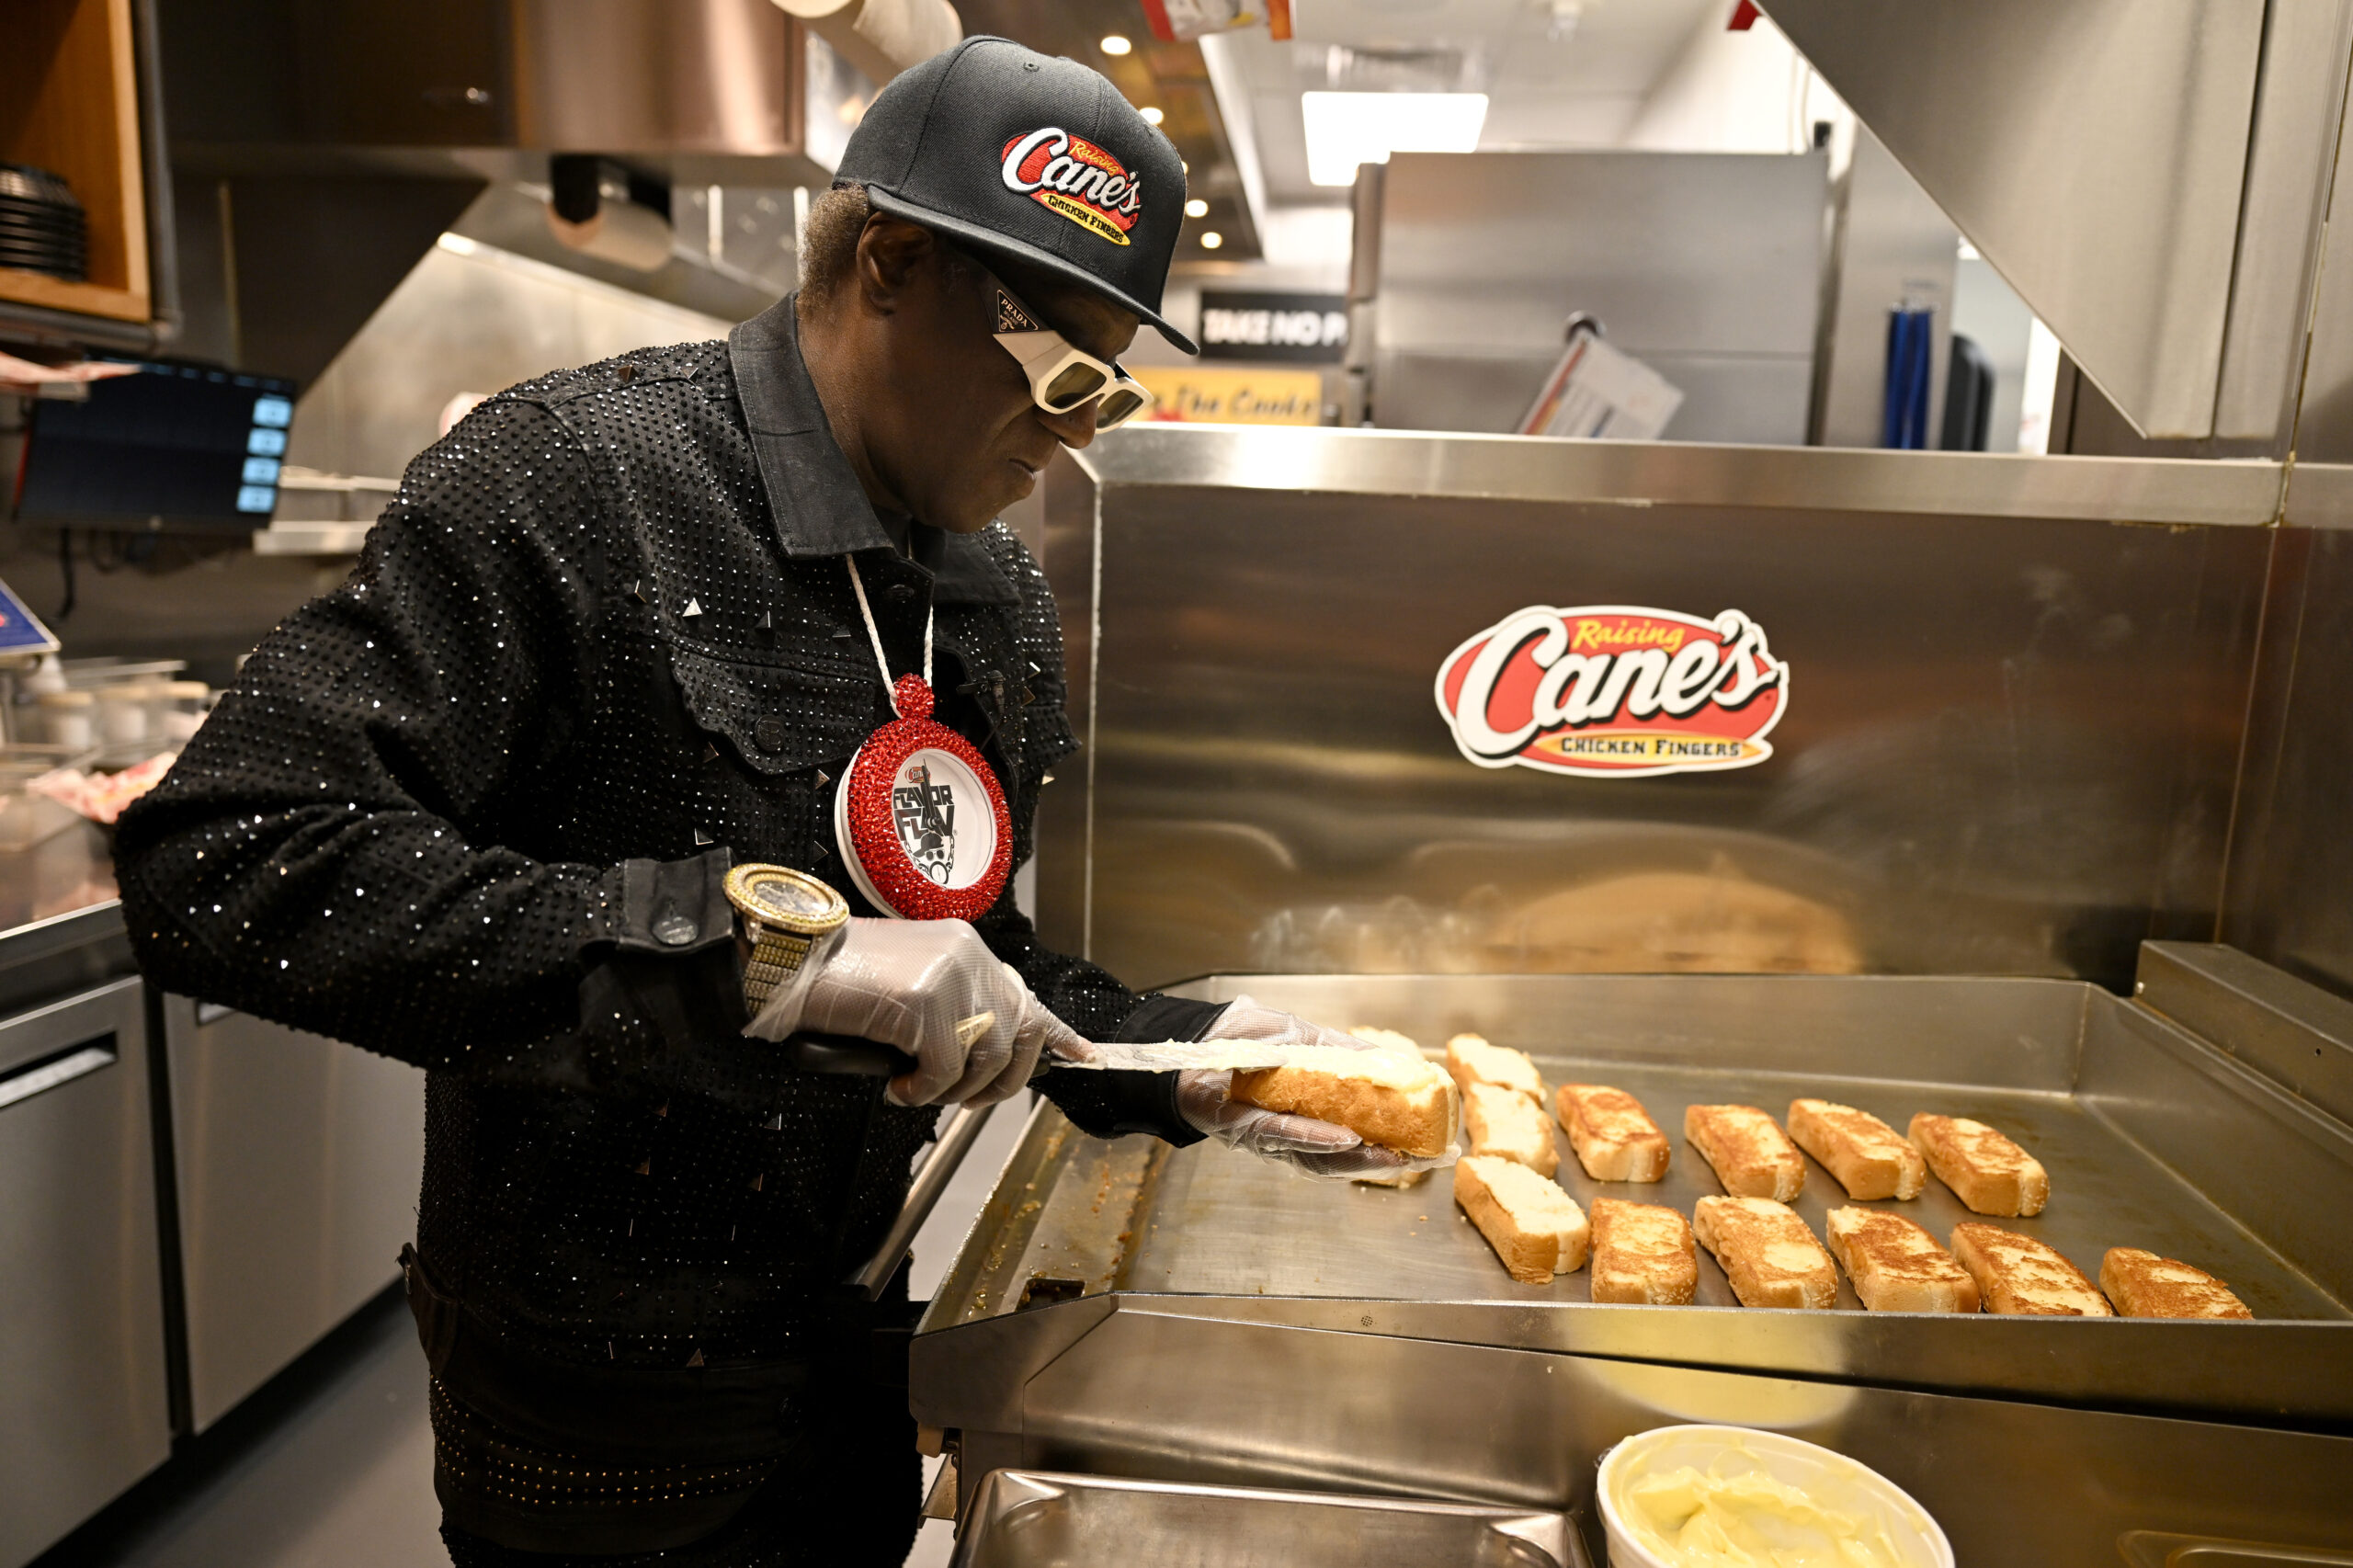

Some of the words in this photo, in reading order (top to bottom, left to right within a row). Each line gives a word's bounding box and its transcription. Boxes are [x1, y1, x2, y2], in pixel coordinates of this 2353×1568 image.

[1002, 127, 1142, 212] Cane's
[1069, 141, 1120, 176] Raising
[1048, 195, 1089, 222] CHICKEN
[1089, 215, 1124, 244] FINGERS
[1001, 299, 1028, 327] PRADA
[1204, 308, 1270, 345] TAKE
[1271, 310, 1322, 347] NO
[1572, 619, 1686, 652] Raising
[1456, 610, 1782, 757] Cane's
[1561, 736, 1646, 756] CHICKEN
[1654, 737, 1742, 757] FINGERS
